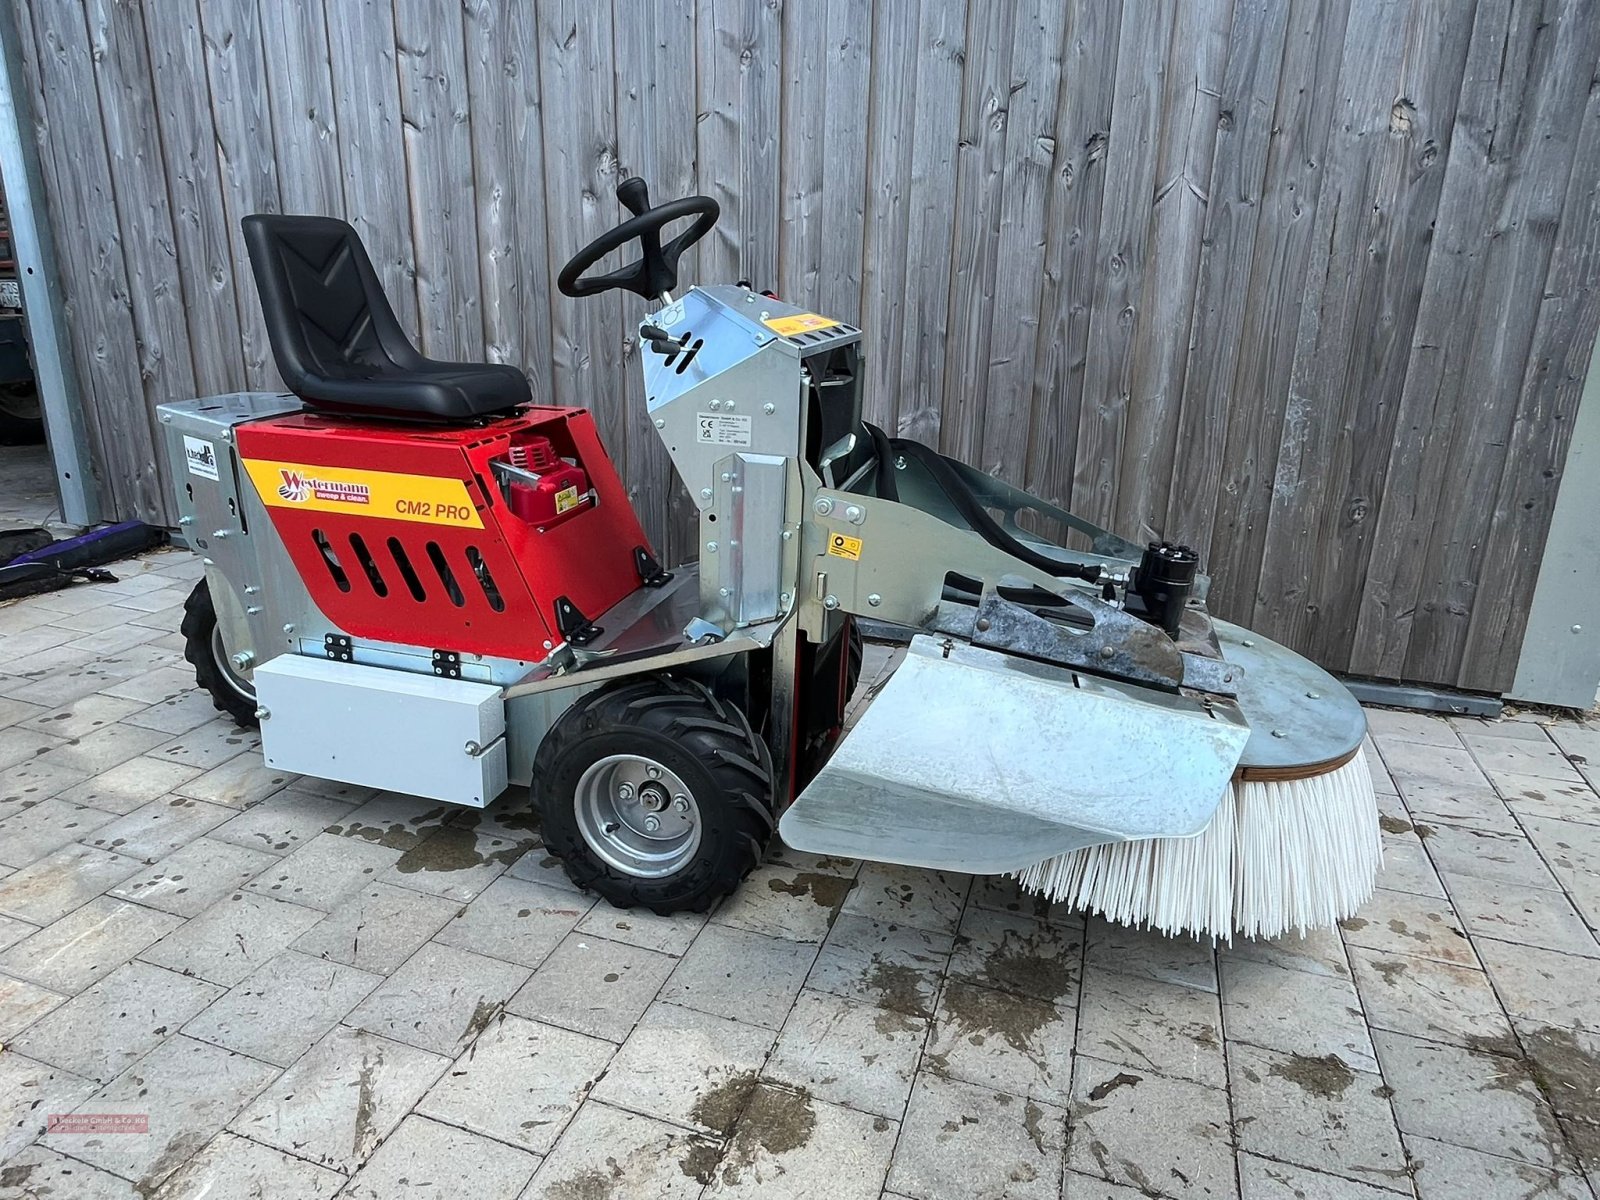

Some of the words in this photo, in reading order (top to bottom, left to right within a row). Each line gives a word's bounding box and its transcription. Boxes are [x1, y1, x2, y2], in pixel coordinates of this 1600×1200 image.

[281, 470, 368, 494] Westermann
[316, 492, 339, 500] sweep
[396, 499, 431, 516] CM2
[435, 503, 470, 520] PRO
